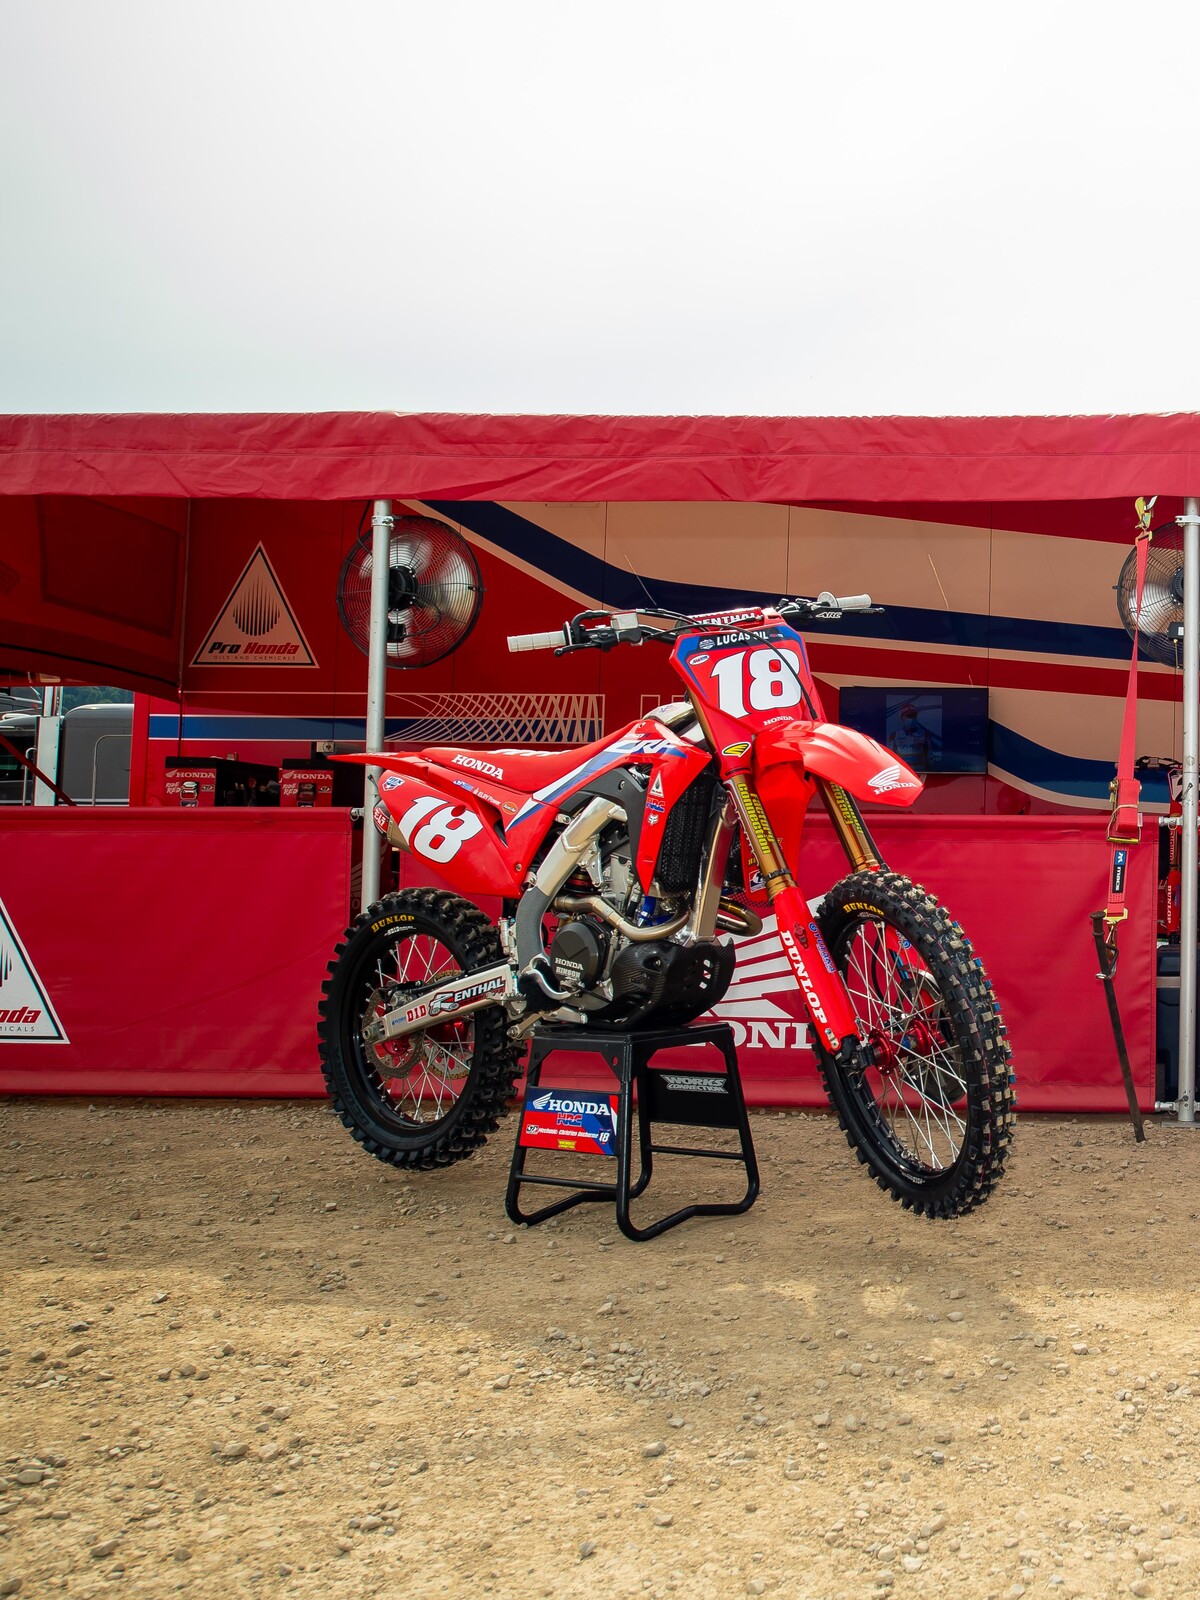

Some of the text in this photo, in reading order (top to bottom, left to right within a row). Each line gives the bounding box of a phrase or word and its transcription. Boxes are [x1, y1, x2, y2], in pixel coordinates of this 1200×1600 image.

[716, 632, 751, 646] LUCAS
[208, 642, 300, 655] Pro Honda
[711, 648, 800, 719] 18
[763, 715, 795, 726] HONDA
[452, 754, 504, 781] HONDA
[874, 782, 918, 795] HONDA
[398, 796, 484, 864] 18
[843, 902, 885, 917] DUNLOP
[370, 914, 415, 933] DUNLOP
[554, 958, 584, 971] HONDA
[780, 930, 828, 1024] DUNLOP
[663, 1075, 727, 1087] WORKS
[667, 1083, 727, 1094] CONNECTION
[548, 1099, 611, 1116] HONDA
[599, 1131, 610, 1143] 18
